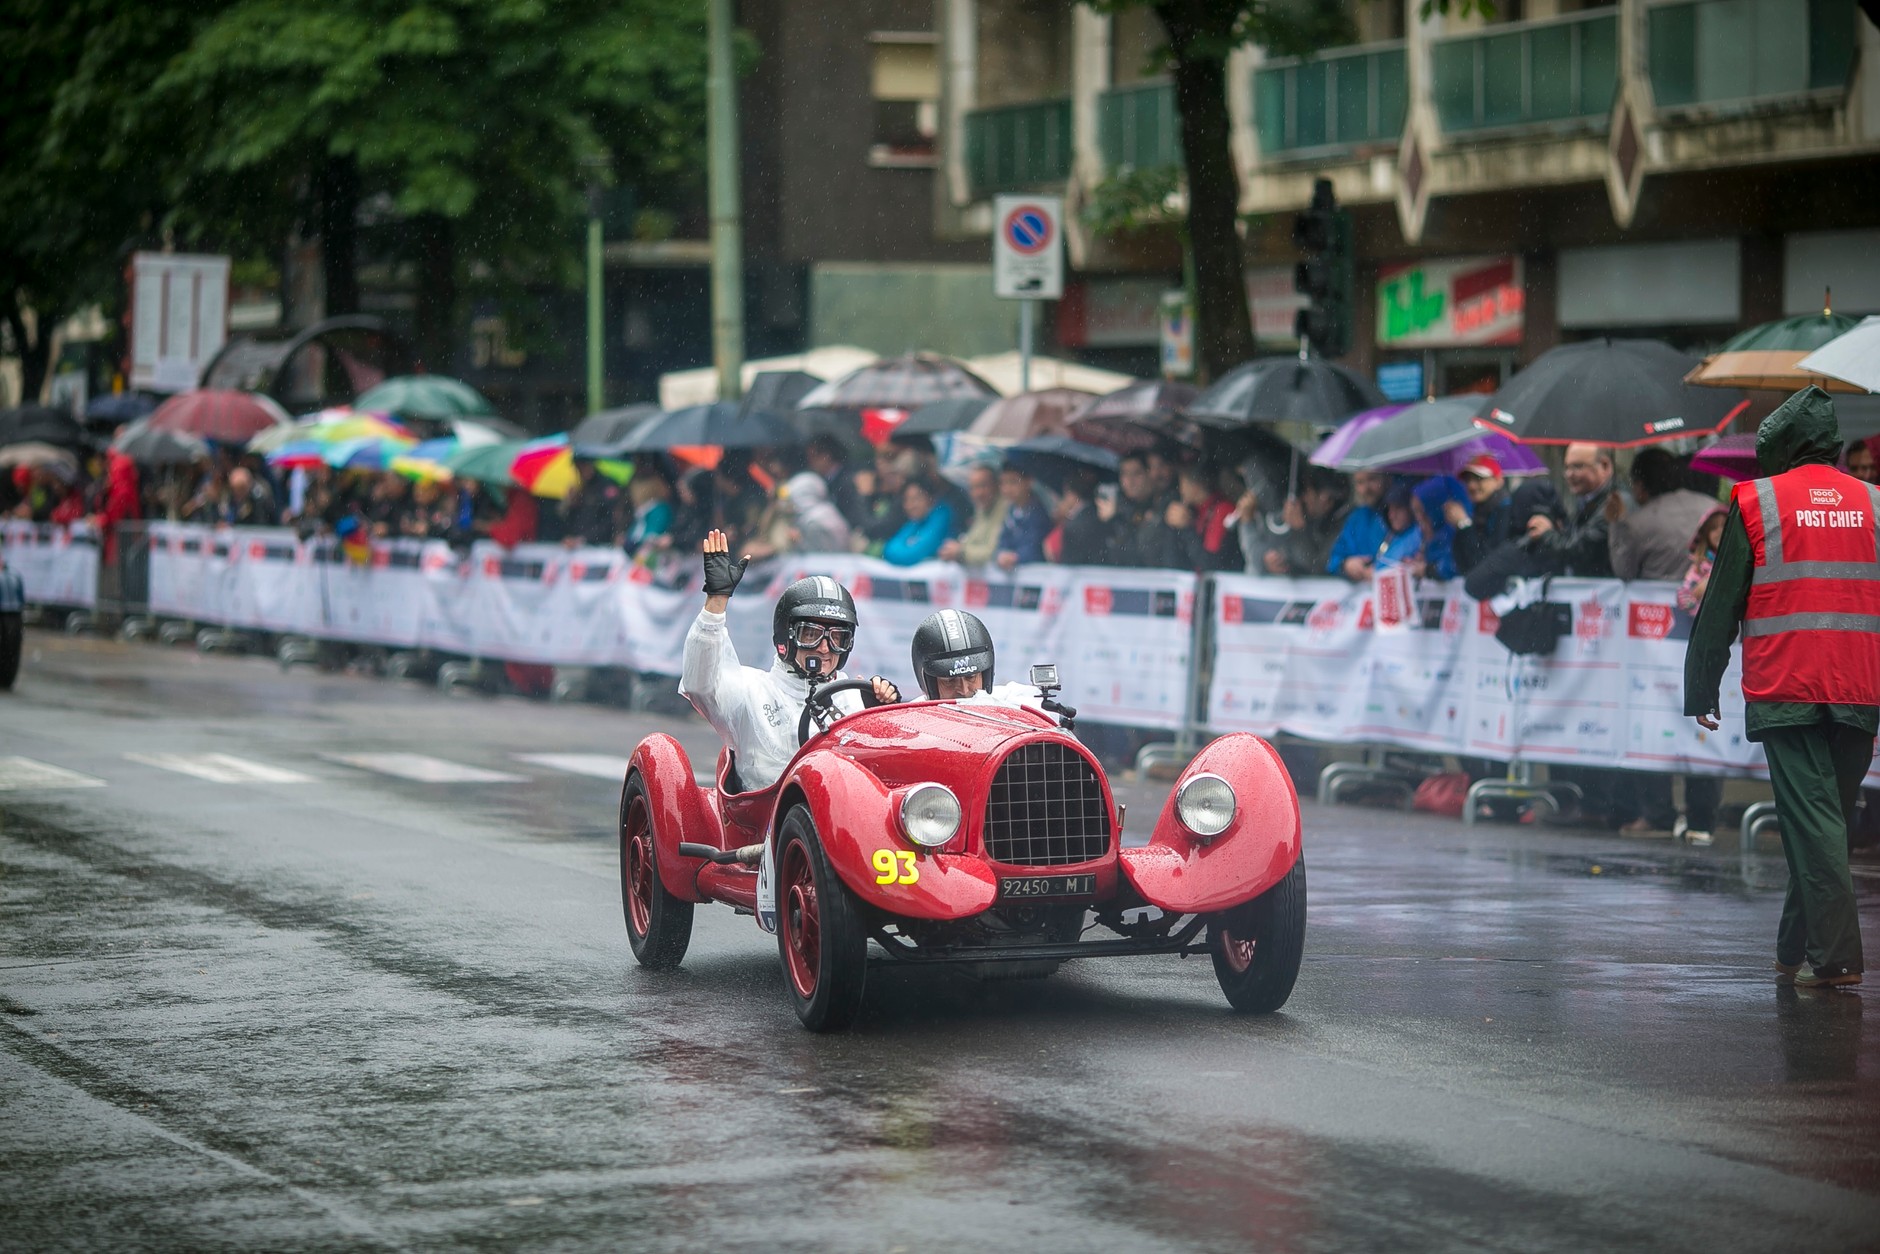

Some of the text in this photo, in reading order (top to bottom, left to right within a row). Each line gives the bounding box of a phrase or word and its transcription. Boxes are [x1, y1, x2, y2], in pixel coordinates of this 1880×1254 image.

[1795, 510, 1864, 528] POST CHIEF
[949, 665, 978, 677] MICAP
[871, 848, 920, 885] 93
[1003, 879, 1050, 895] 92450
